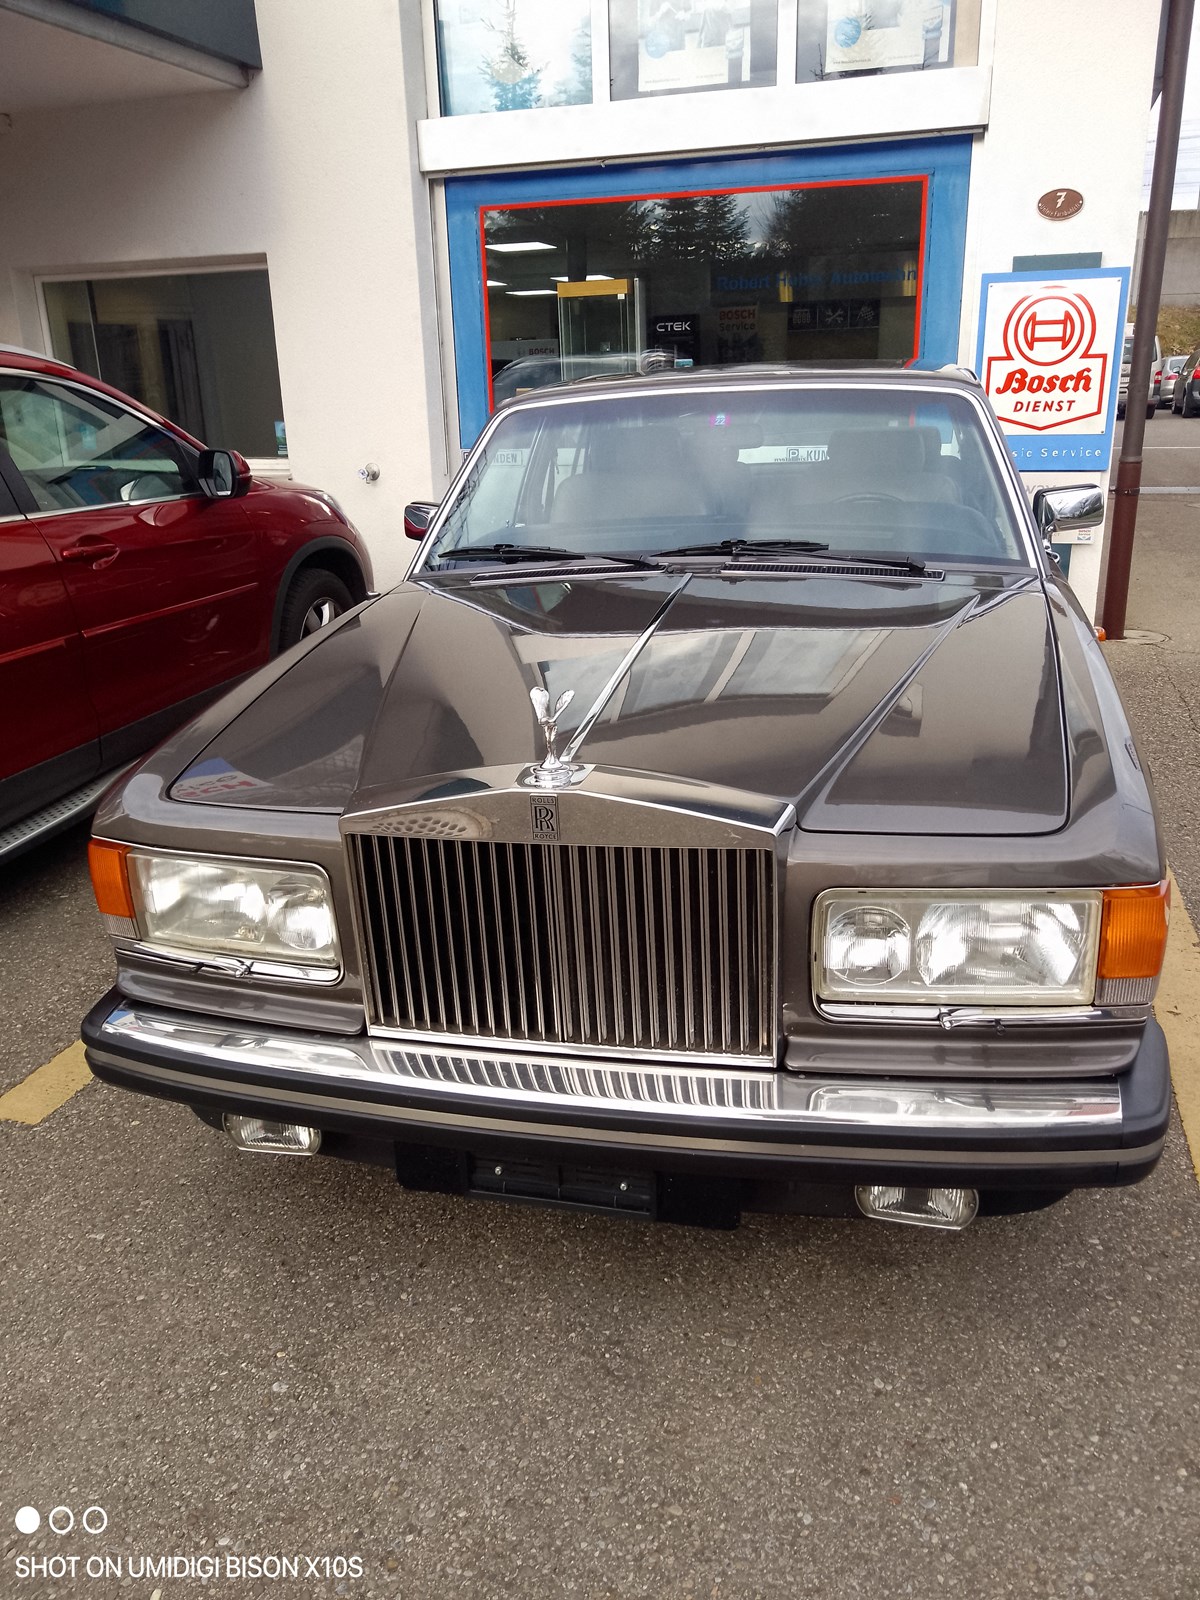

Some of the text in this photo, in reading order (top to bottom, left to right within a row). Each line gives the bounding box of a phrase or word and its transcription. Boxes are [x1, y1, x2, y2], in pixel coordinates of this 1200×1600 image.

[1056, 191, 1067, 209] 7
[717, 275, 769, 290] Robert
[719, 309, 756, 321] BOSCH
[656, 321, 691, 332] CTEK
[719, 322, 756, 333] Service
[995, 367, 1092, 395] Bosch
[1013, 400, 1076, 412] DIENST
[1041, 447, 1101, 458] Service
